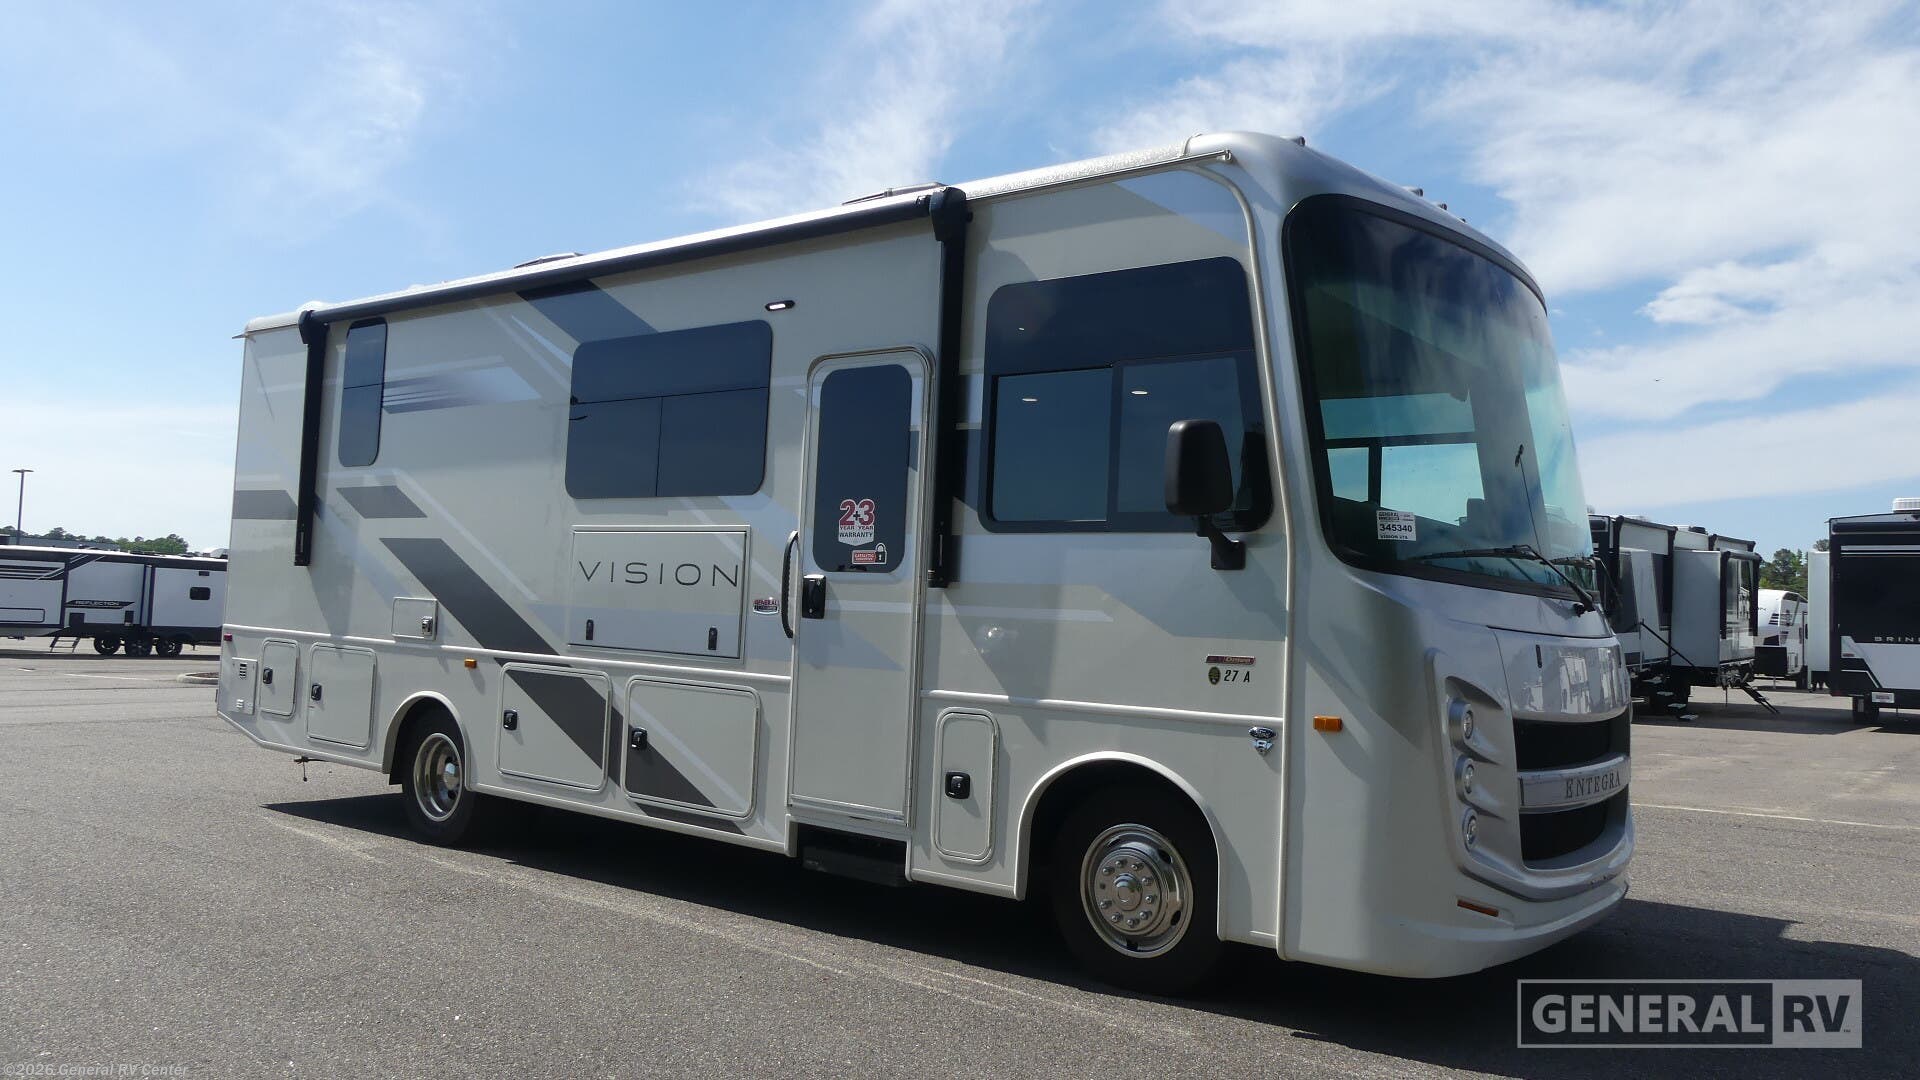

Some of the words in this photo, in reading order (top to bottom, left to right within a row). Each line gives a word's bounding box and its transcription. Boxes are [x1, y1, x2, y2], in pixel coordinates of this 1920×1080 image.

[1379, 523, 1413, 532] 345340
[578, 560, 739, 588] VISION
[1223, 669, 1239, 682] 27
[1243, 670, 1251, 683] A
[1564, 769, 1621, 798] ENTEGRA
